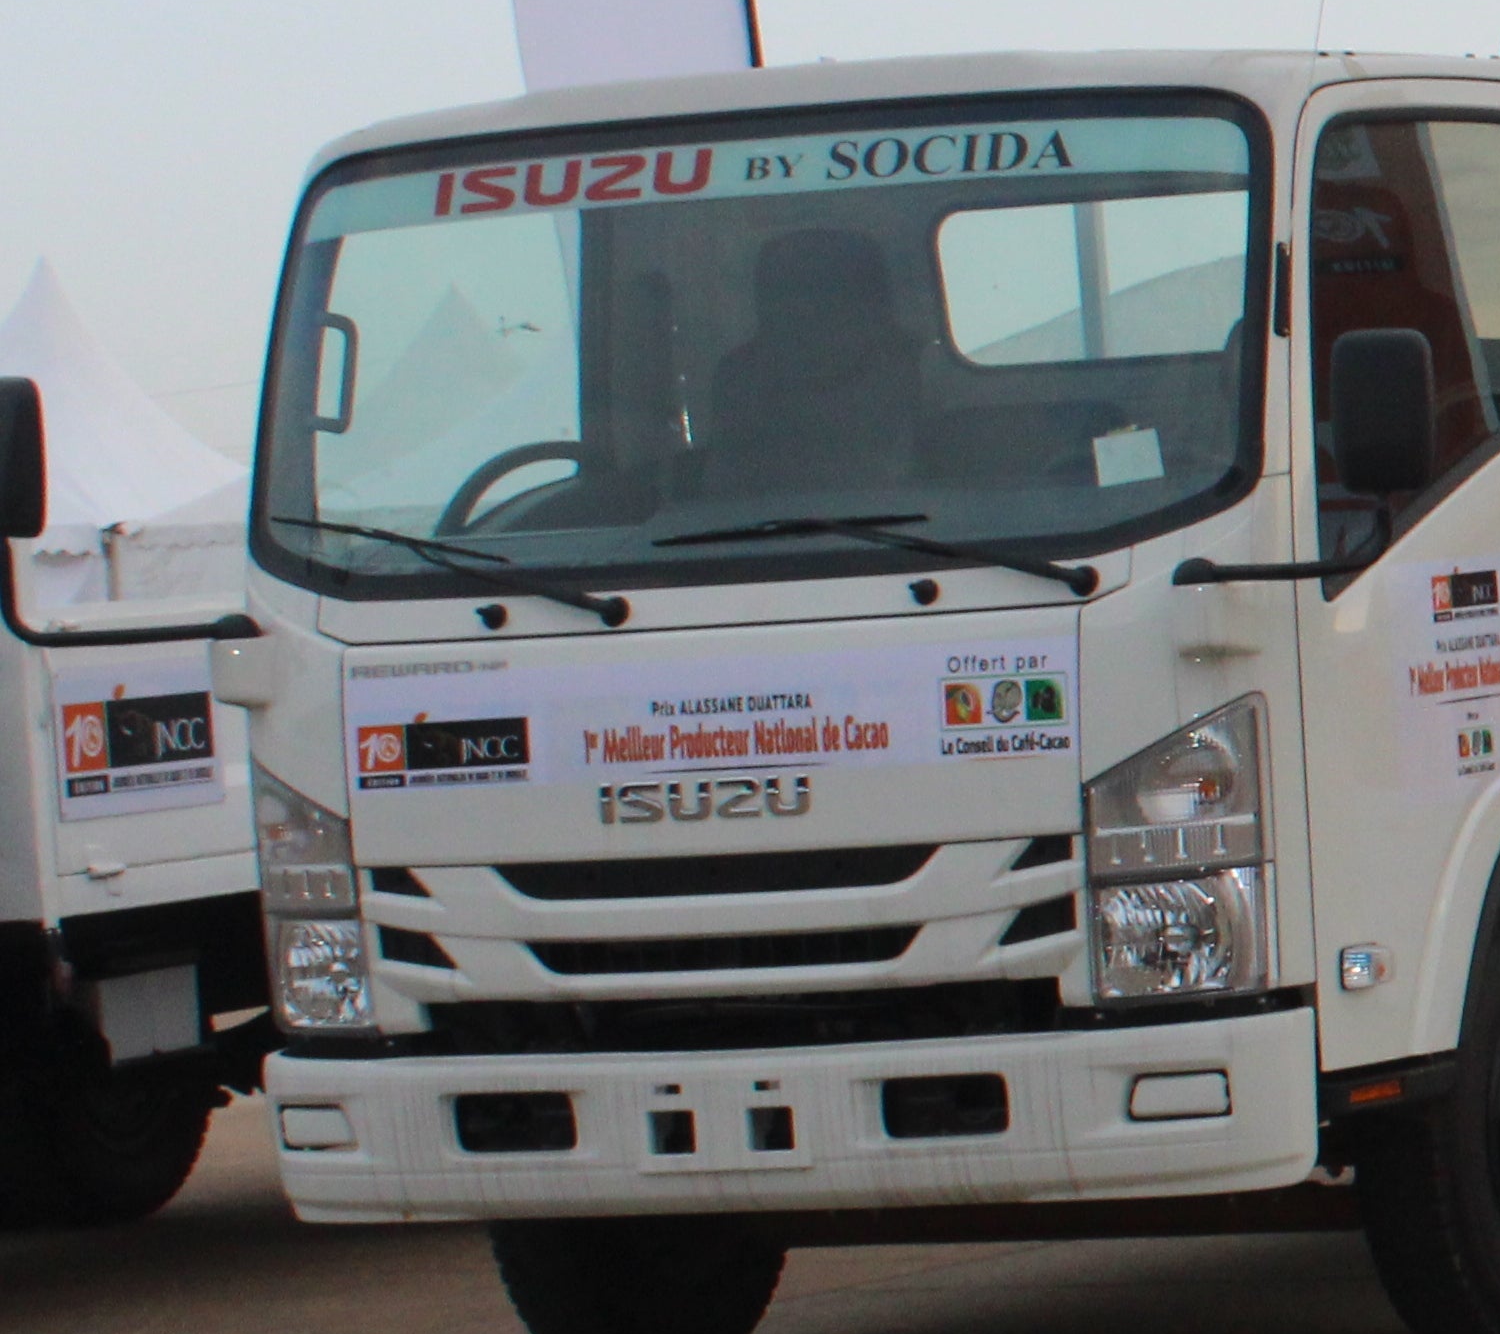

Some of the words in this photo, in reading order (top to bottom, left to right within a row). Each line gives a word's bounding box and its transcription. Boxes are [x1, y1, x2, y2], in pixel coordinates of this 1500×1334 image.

[434, 148, 713, 216] ISUZU
[744, 154, 804, 182] BY
[826, 129, 1075, 181] SOCIDA
[947, 654, 1005, 673] Offert
[1016, 654, 1048, 672] par
[652, 700, 676, 717] Prix
[680, 696, 743, 715] ALASSANE
[748, 694, 812, 712] OUATTARA
[154, 718, 206, 758] JNCC
[461, 736, 519, 764] JNCC
[604, 725, 665, 763] Meilleur
[670, 721, 749, 760] Producteur
[754, 717, 818, 754] National
[822, 716, 841, 752] de
[845, 714, 889, 750] Cacao
[942, 738, 953, 755] Le
[956, 735, 994, 754] Conseil
[997, 734, 1009, 752] du
[1012, 731, 1071, 751] Café-Cacao
[600, 773, 812, 825] ISUZU
